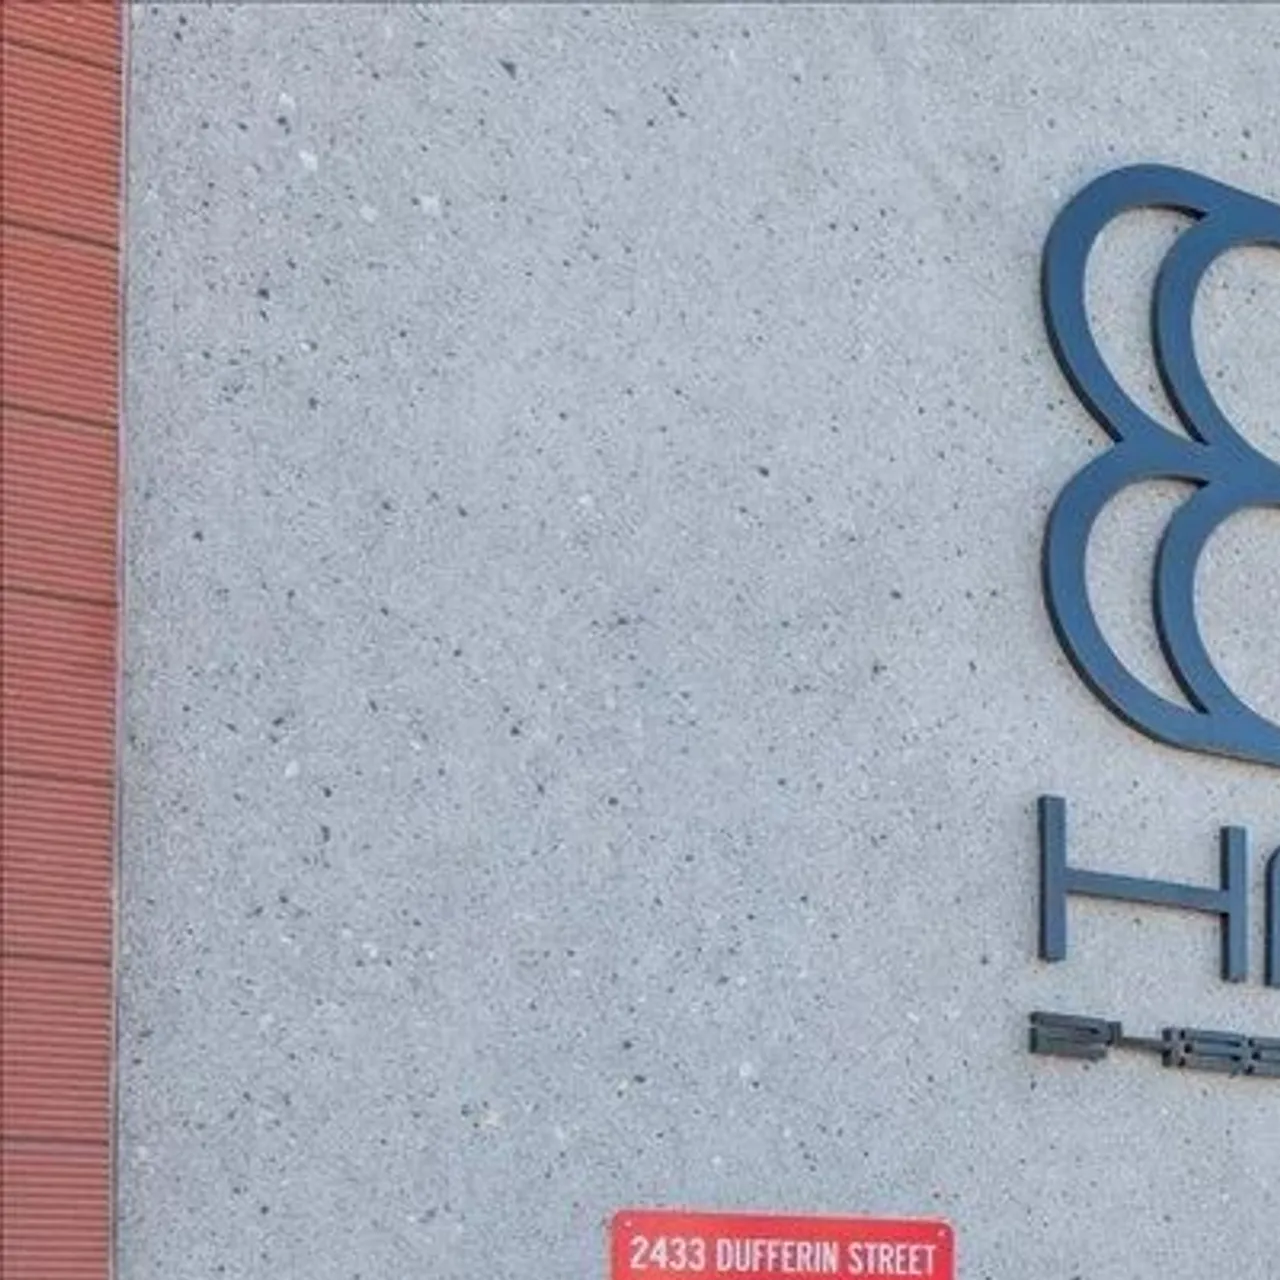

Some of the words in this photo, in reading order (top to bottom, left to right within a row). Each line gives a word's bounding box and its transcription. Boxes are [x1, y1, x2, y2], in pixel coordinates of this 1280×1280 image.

[630, 1237, 705, 1271] 2433
[716, 1239, 838, 1274] DUFFERIN
[849, 1243, 936, 1275] STREET
